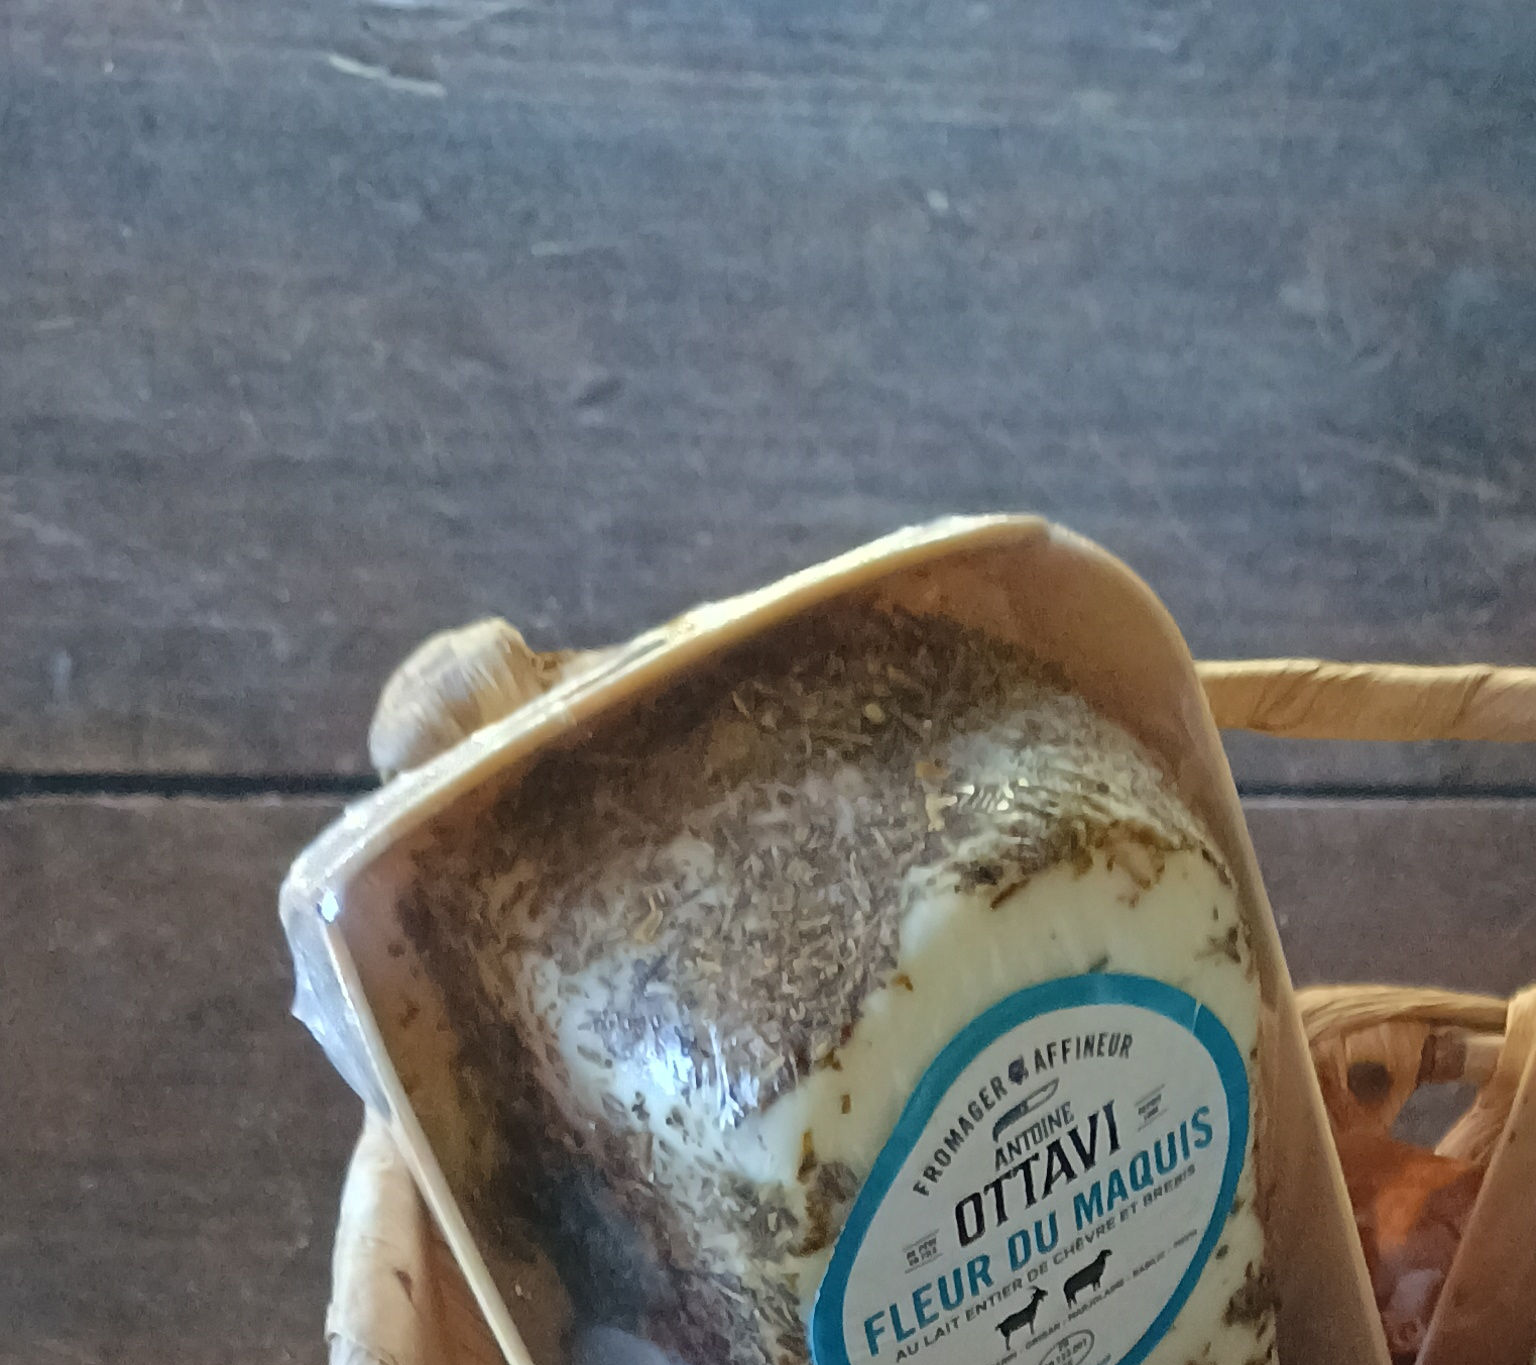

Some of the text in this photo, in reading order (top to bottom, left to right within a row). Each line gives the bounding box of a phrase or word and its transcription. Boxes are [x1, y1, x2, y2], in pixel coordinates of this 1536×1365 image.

[913, 1032, 1133, 1198] FROMAGER AFFINEUR
[955, 1101, 1122, 1248] OTTAVI
[992, 1101, 1075, 1171] ANTOINE
[864, 1105, 1214, 1356] FLEUR DU MAQUIS
[896, 1338, 925, 1364] AU
[925, 1317, 959, 1348] LAIT
[966, 1280, 1023, 1322] ENTIER
[1027, 1259, 1048, 1283] DE
[1119, 1201, 1137, 1222] ET
[1143, 1163, 1196, 1206] BREBIS
